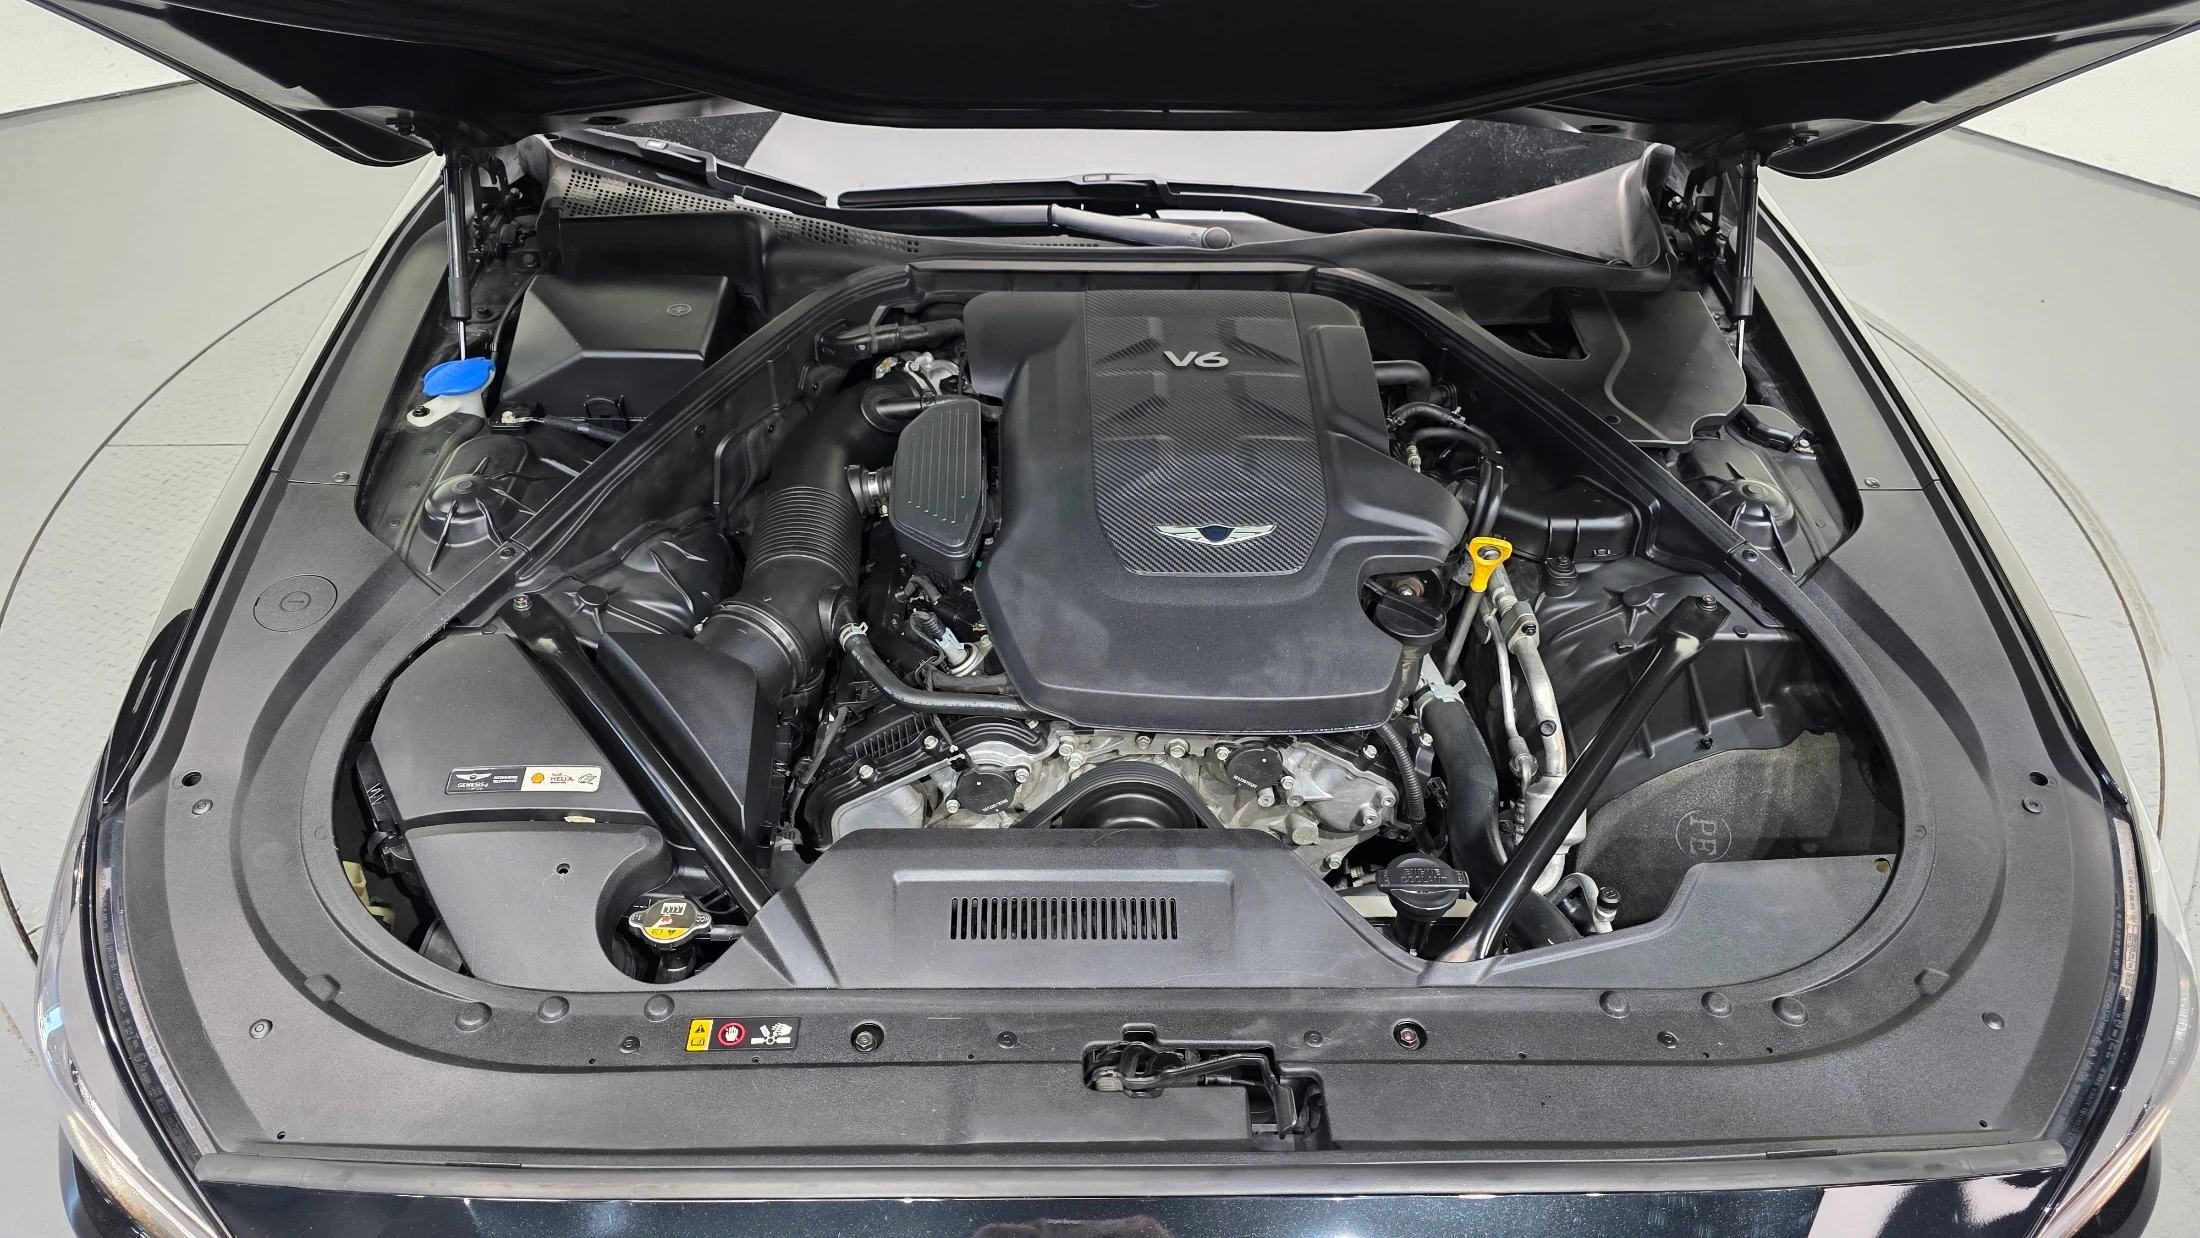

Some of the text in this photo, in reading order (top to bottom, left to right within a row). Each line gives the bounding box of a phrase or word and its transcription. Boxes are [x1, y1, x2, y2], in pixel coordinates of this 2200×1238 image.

[1163, 351, 1229, 368] V6
[1689, 816, 1717, 855] PE
[1403, 868, 1441, 876] ENGINE
[1400, 876, 1447, 884] COOLANT
